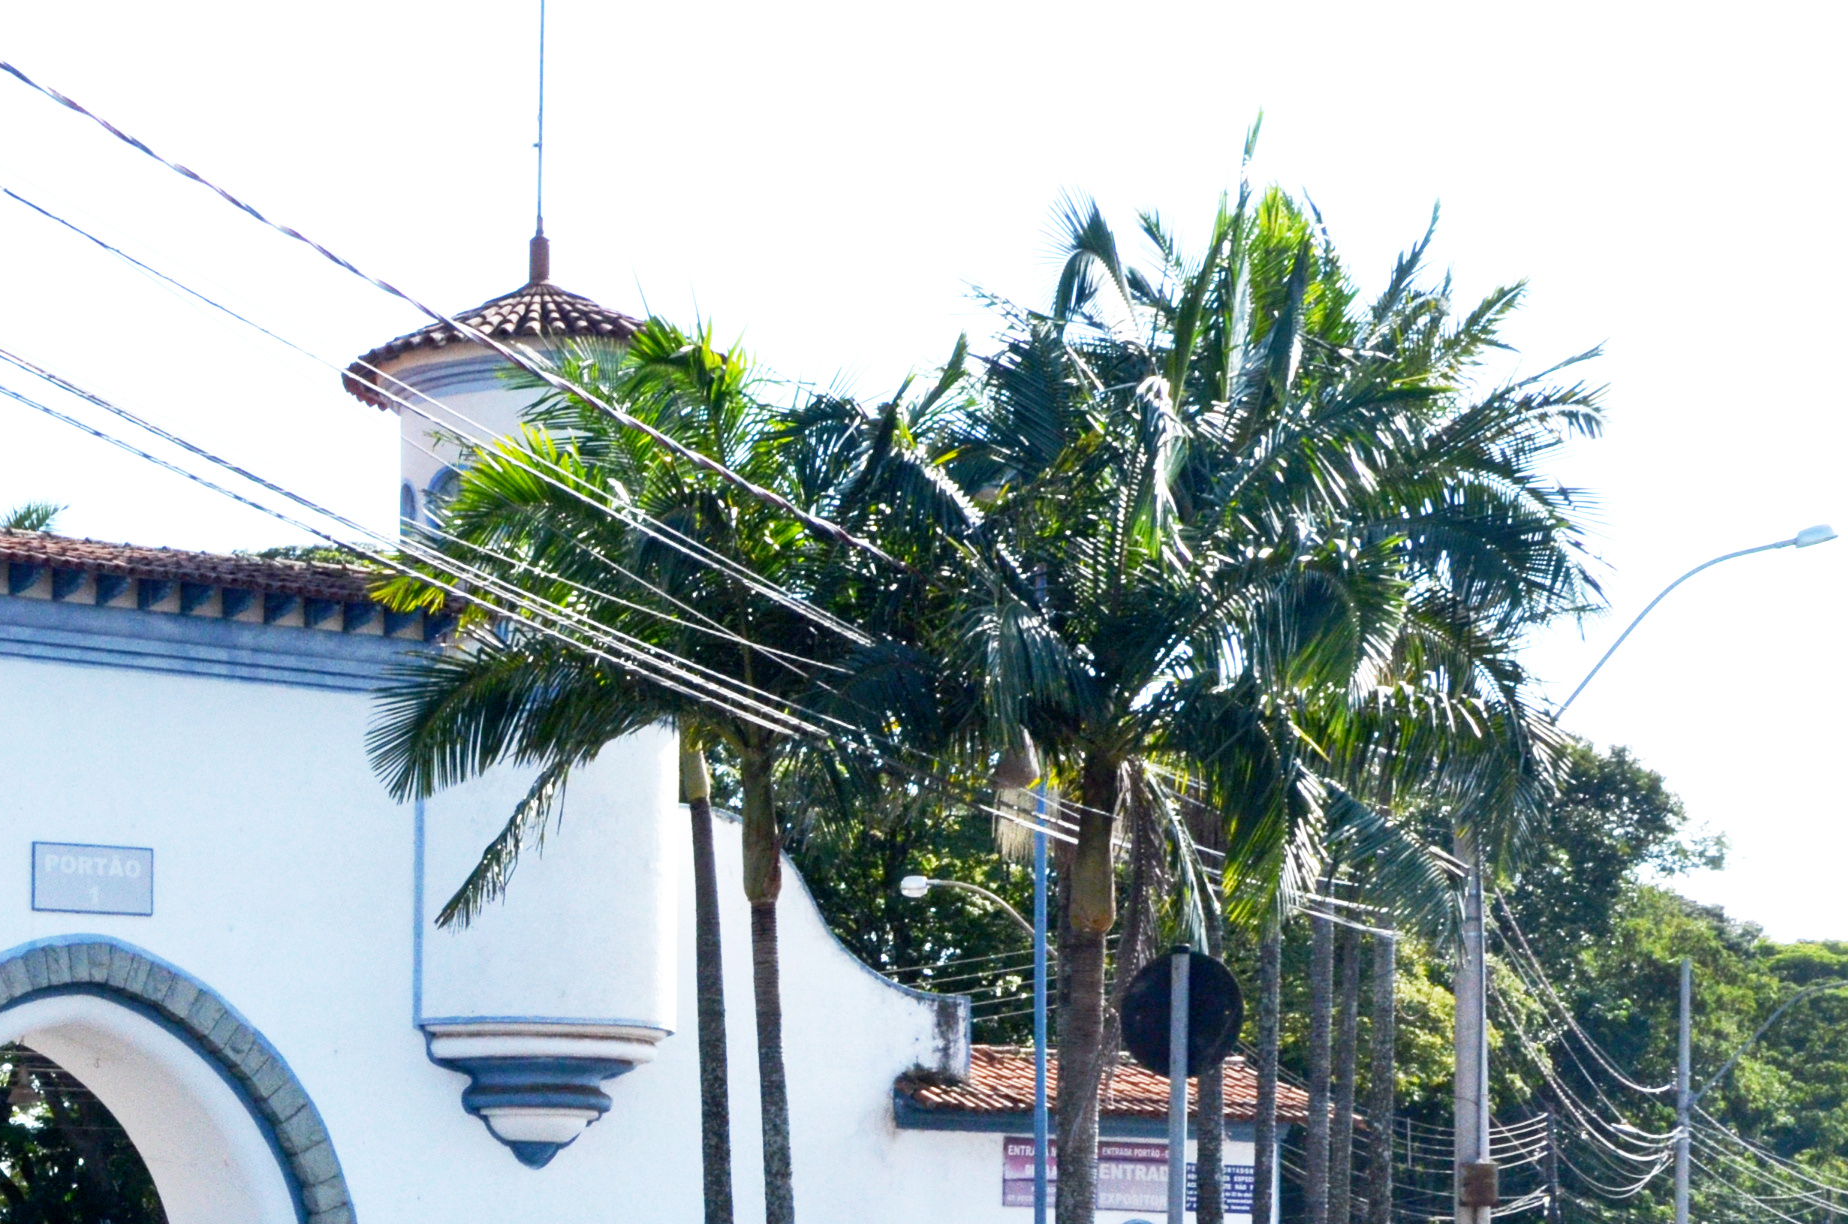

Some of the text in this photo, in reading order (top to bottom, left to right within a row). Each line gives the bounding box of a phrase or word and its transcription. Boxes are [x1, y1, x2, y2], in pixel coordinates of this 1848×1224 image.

[44, 852, 142, 881] PORTÃO
[89, 885, 100, 905] 1
[1099, 1162, 1169, 1182] ENTRAD
